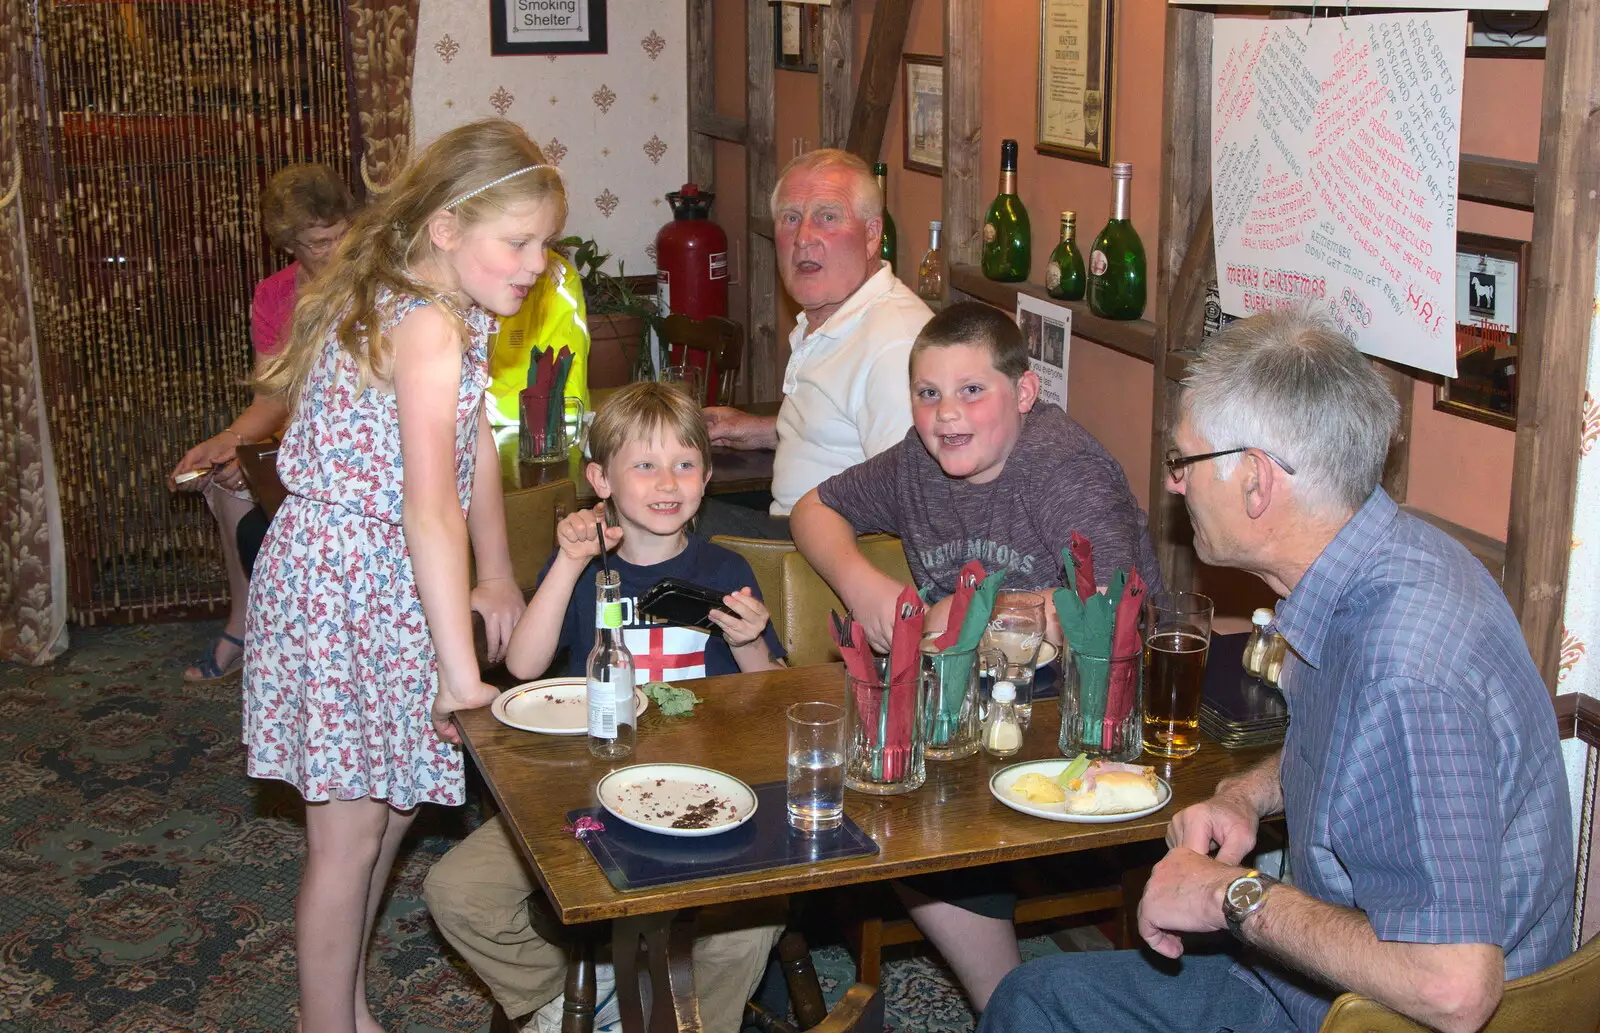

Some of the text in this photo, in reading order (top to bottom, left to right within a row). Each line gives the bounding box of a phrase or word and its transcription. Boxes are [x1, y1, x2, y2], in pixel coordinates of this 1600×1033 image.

[518, 0, 576, 13] Smoking
[524, 13, 571, 26] Shelter
[1392, 22, 1419, 88] ATTEMPT
[1417, 91, 1434, 123] THE
[1407, 18, 1456, 133] REASONS DO NOT
[1421, 20, 1457, 95] FOR SAFETY
[1301, 66, 1320, 95] SANTA
[1368, 24, 1380, 52] THE
[1376, 58, 1389, 85] AID
[1387, 89, 1397, 104] OF
[1394, 110, 1403, 121] A
[1401, 122, 1427, 172] SAFETY
[1380, 23, 1443, 169] CROSSWORD WITHOUT
[1369, 117, 1405, 153] PERSONAL
[1357, 129, 1422, 183] AND HEARTFELT
[1409, 188, 1426, 208] THE
[1410, 212, 1433, 232] HAVE
[1227, 266, 1326, 298] MERRY CHRISTMAS
[1379, 256, 1402, 283] JOKE
[1402, 249, 1424, 273] YEAR
[1426, 266, 1442, 285] FOR
